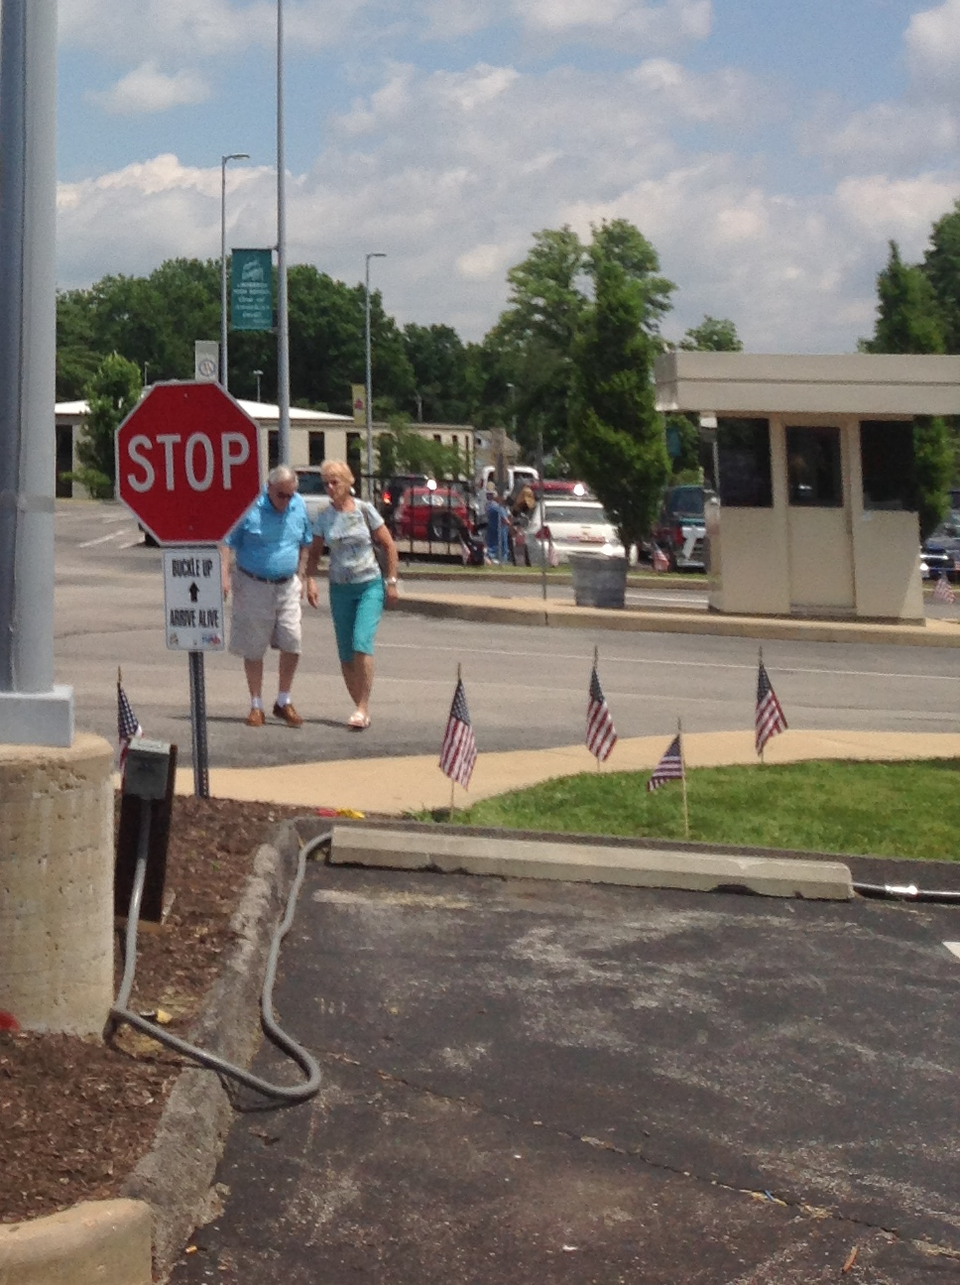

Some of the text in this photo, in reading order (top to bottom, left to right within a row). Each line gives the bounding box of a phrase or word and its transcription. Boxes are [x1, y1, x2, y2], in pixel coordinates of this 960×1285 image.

[127, 432, 250, 492] STOP
[172, 558, 213, 578] BUCKLE UP
[170, 609, 219, 628] ARRIVE ALIVE
